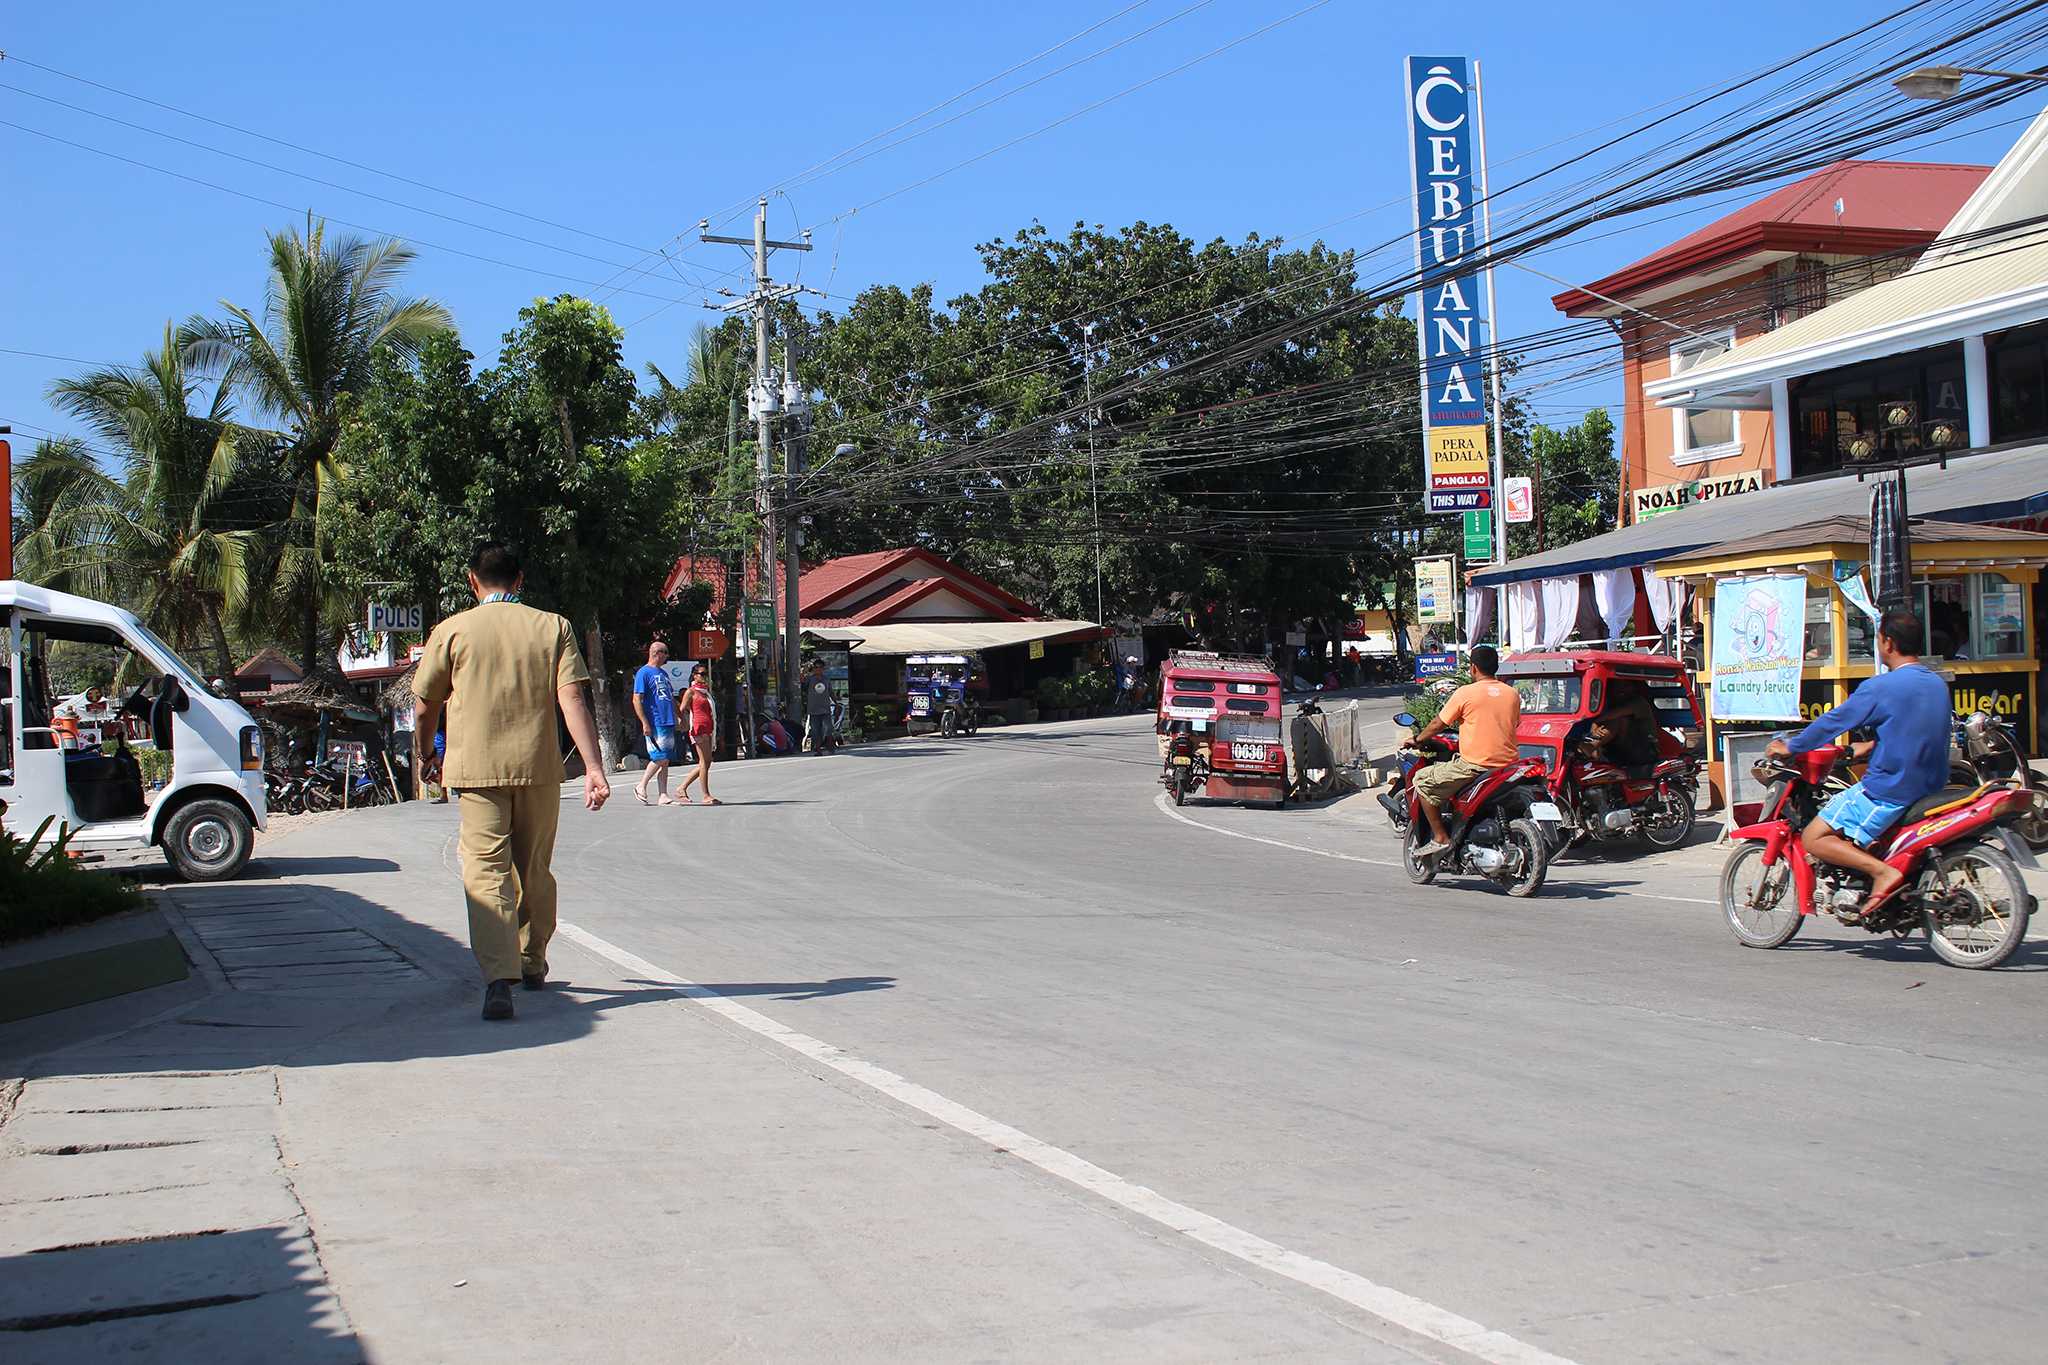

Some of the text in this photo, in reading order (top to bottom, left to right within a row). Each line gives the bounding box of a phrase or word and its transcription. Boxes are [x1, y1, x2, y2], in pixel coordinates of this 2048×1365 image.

[1442, 438, 1474, 450] PERA
[1434, 450, 1484, 463] PADALA
[1434, 475, 1486, 486] PANGLAO
[1432, 493, 1479, 507] THIS WAY
[1638, 476, 1760, 511] NOAH PIZZA
[374, 607, 421, 629] PULIS
[1720, 679, 1795, 696] Laundry Service
[1954, 688, 2023, 717] Wear
